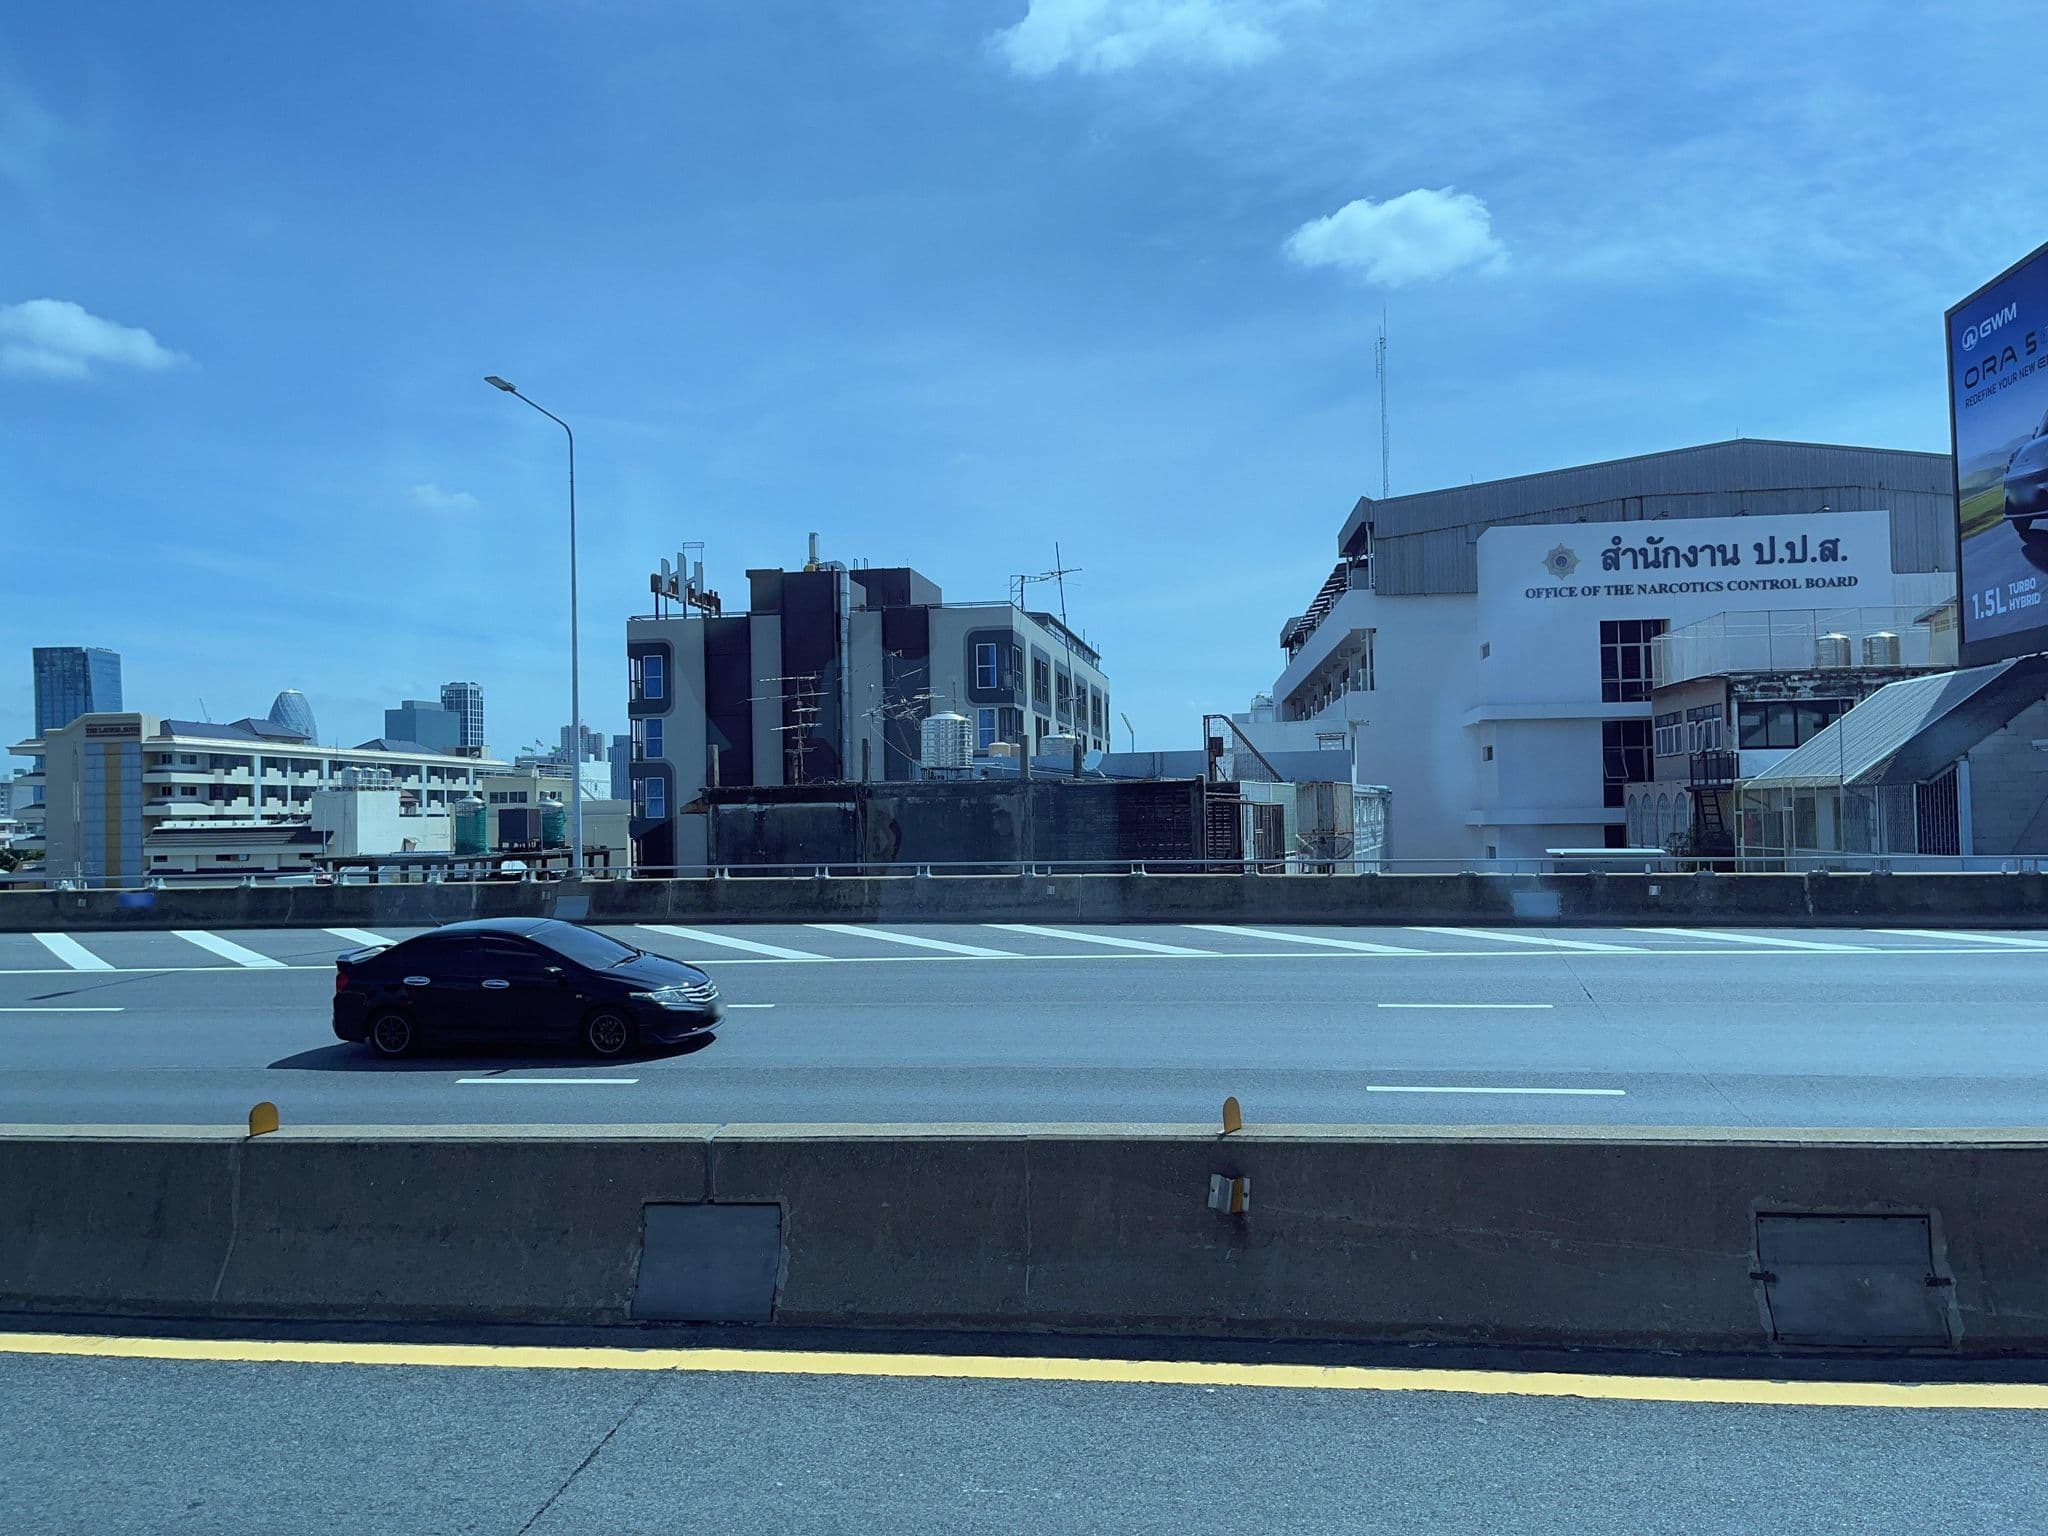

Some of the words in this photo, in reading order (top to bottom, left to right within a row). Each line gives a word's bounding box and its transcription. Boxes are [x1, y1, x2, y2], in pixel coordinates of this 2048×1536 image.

[1980, 302, 2017, 338] GWM
[1964, 345, 2017, 389] ORA
[1965, 384, 1997, 409] REDEFINE
[1999, 371, 2018, 390] YOUR
[2019, 361, 2035, 378] NEW
[1601, 535, 1740, 571] สำนักงาน
[1753, 534, 1848, 565] ป.ป.ส.
[1525, 586, 1578, 599] OFFICE
[1581, 585, 1601, 597] OF
[1604, 584, 1634, 596] THE
[1637, 581, 1724, 595] NARCOTICS
[1727, 578, 1802, 592] CONTROL
[1805, 575, 1859, 589] BOARD
[1972, 587, 2007, 620] 1.5L
[2008, 577, 2036, 596] TURBO
[2009, 592, 2041, 611] HYBRID
